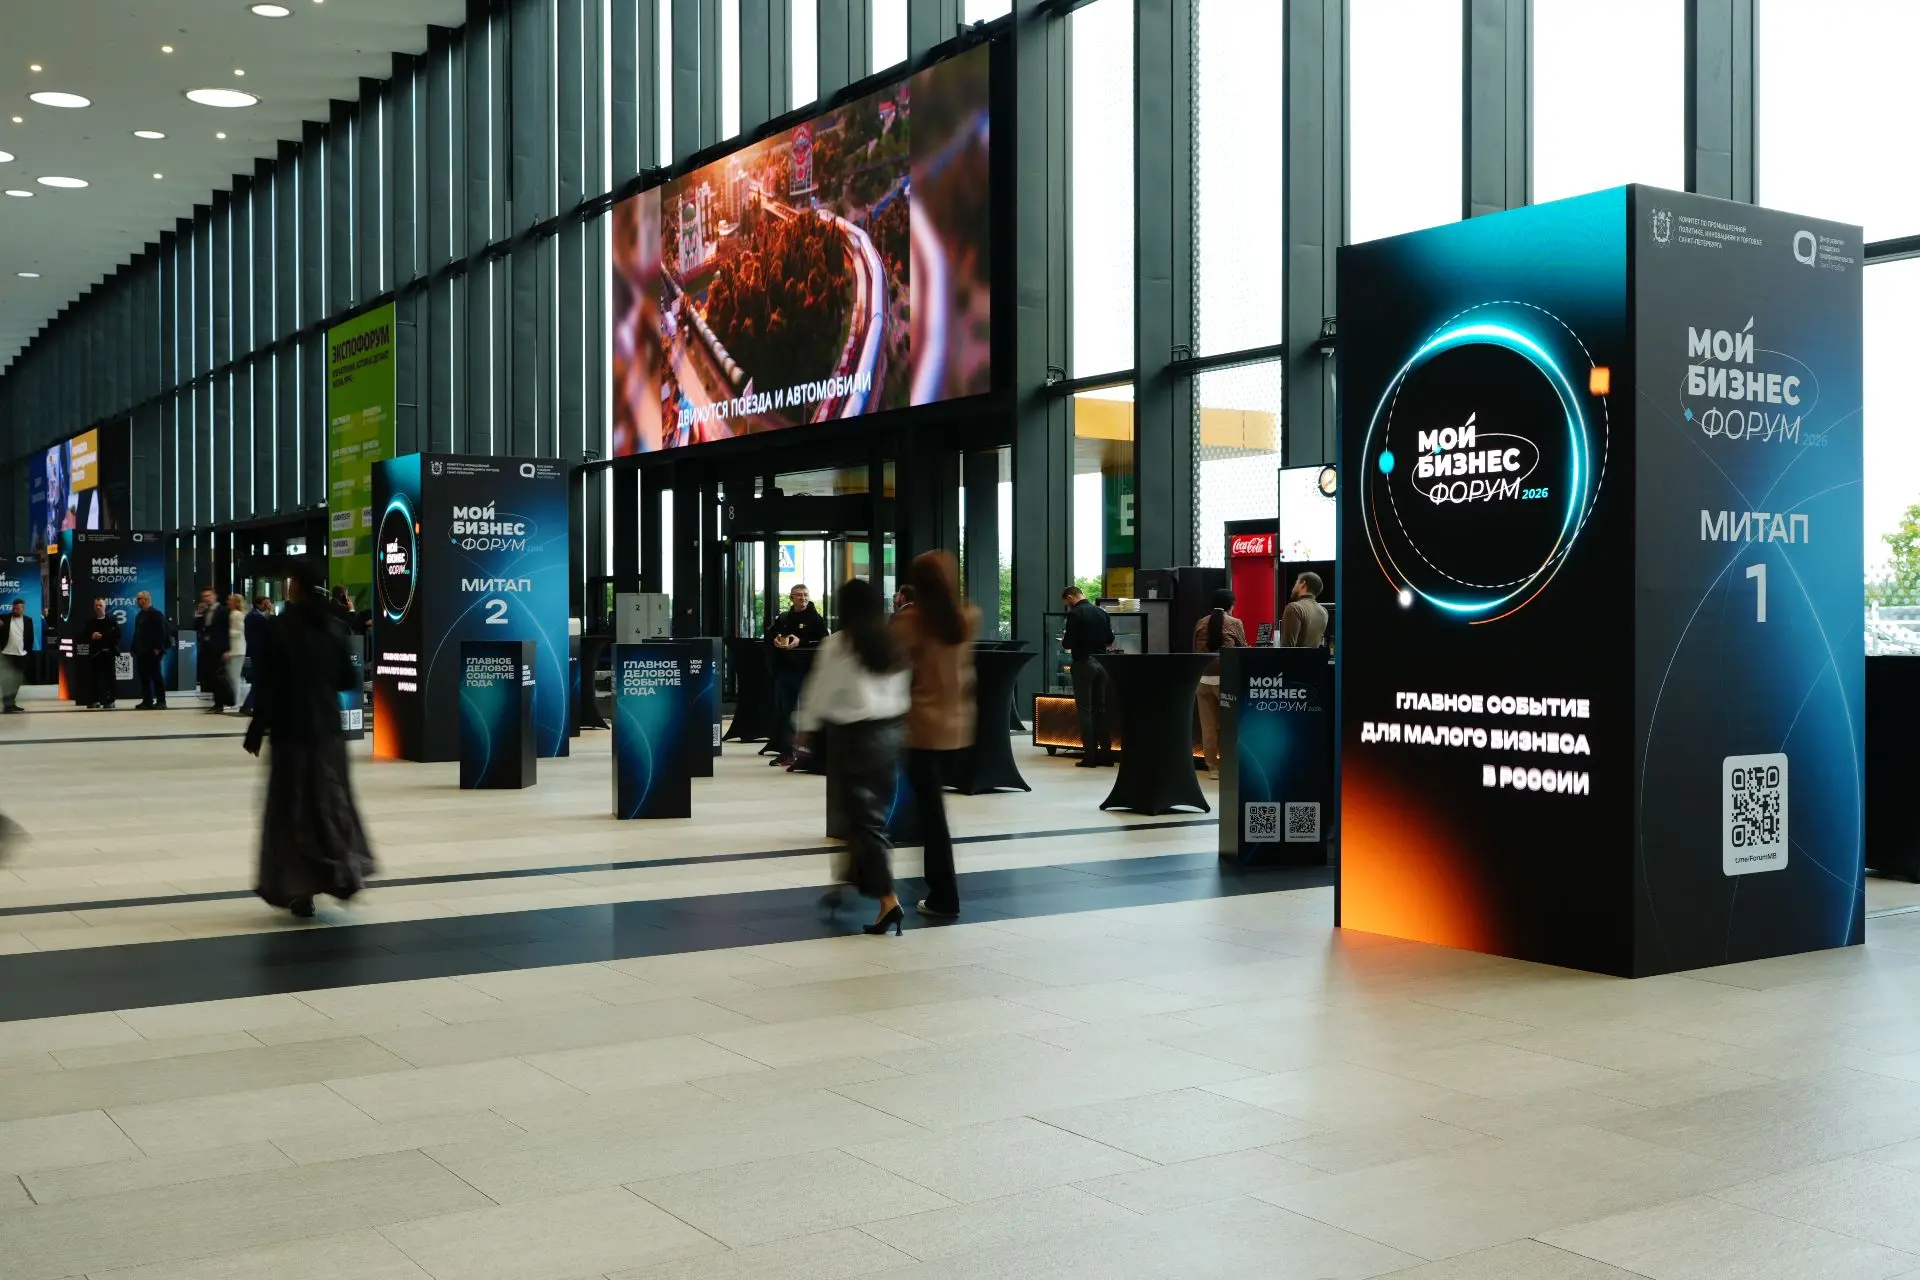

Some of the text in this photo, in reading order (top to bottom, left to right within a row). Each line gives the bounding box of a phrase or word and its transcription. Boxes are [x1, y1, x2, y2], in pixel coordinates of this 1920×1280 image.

[332, 324, 390, 364] ЭКСПОФОРУМ
[1688, 315, 1754, 364] МОЙ
[1688, 364, 1801, 406] БИЗНЕС
[677, 371, 871, 429] ДВИЖУТСЯ ПОЕЗДА И АВТОМОБИЛИ
[1418, 411, 1477, 452] МОЙ
[1701, 405, 1828, 448] ФОРУМ 2026
[1418, 448, 1520, 478] БИЗНЕС
[1428, 477, 1549, 506] ФОРУМ 2026
[453, 500, 495, 520] МОЙ
[453, 521, 526, 536] БИЗНЕС
[1700, 508, 1809, 545] МИТАП
[461, 537, 526, 552] ФОРУМ
[91, 555, 119, 566] МОЙ
[91, 566, 137, 574] БИЗНЕС
[97, 575, 138, 583] ФОРУМ
[461, 578, 531, 592] МИТАП
[1744, 563, 1768, 624] 1
[112, 609, 128, 625] 3
[485, 599, 509, 624] 2
[466, 657, 512, 665] ГЛАВНОЕ
[623, 660, 678, 669] ГЛАВНОЕ
[466, 672, 515, 680] СОБЫТИЕ
[623, 669, 681, 678] ДЕЛОВОЕ
[1249, 671, 1284, 688] МОЙ
[466, 679, 494, 687] ГОДА
[623, 677, 682, 687] СОБЫТИЕ
[623, 687, 656, 696] ГОДА
[1249, 688, 1307, 699] БИЗНЕС
[1255, 700, 1307, 712] ФОРУМ
[1396, 691, 1590, 719] ГЛАВНОЕ СОБЫТИЕ
[1361, 721, 1401, 744] ДЛЯ
[1404, 723, 1487, 748] МАЛОГО
